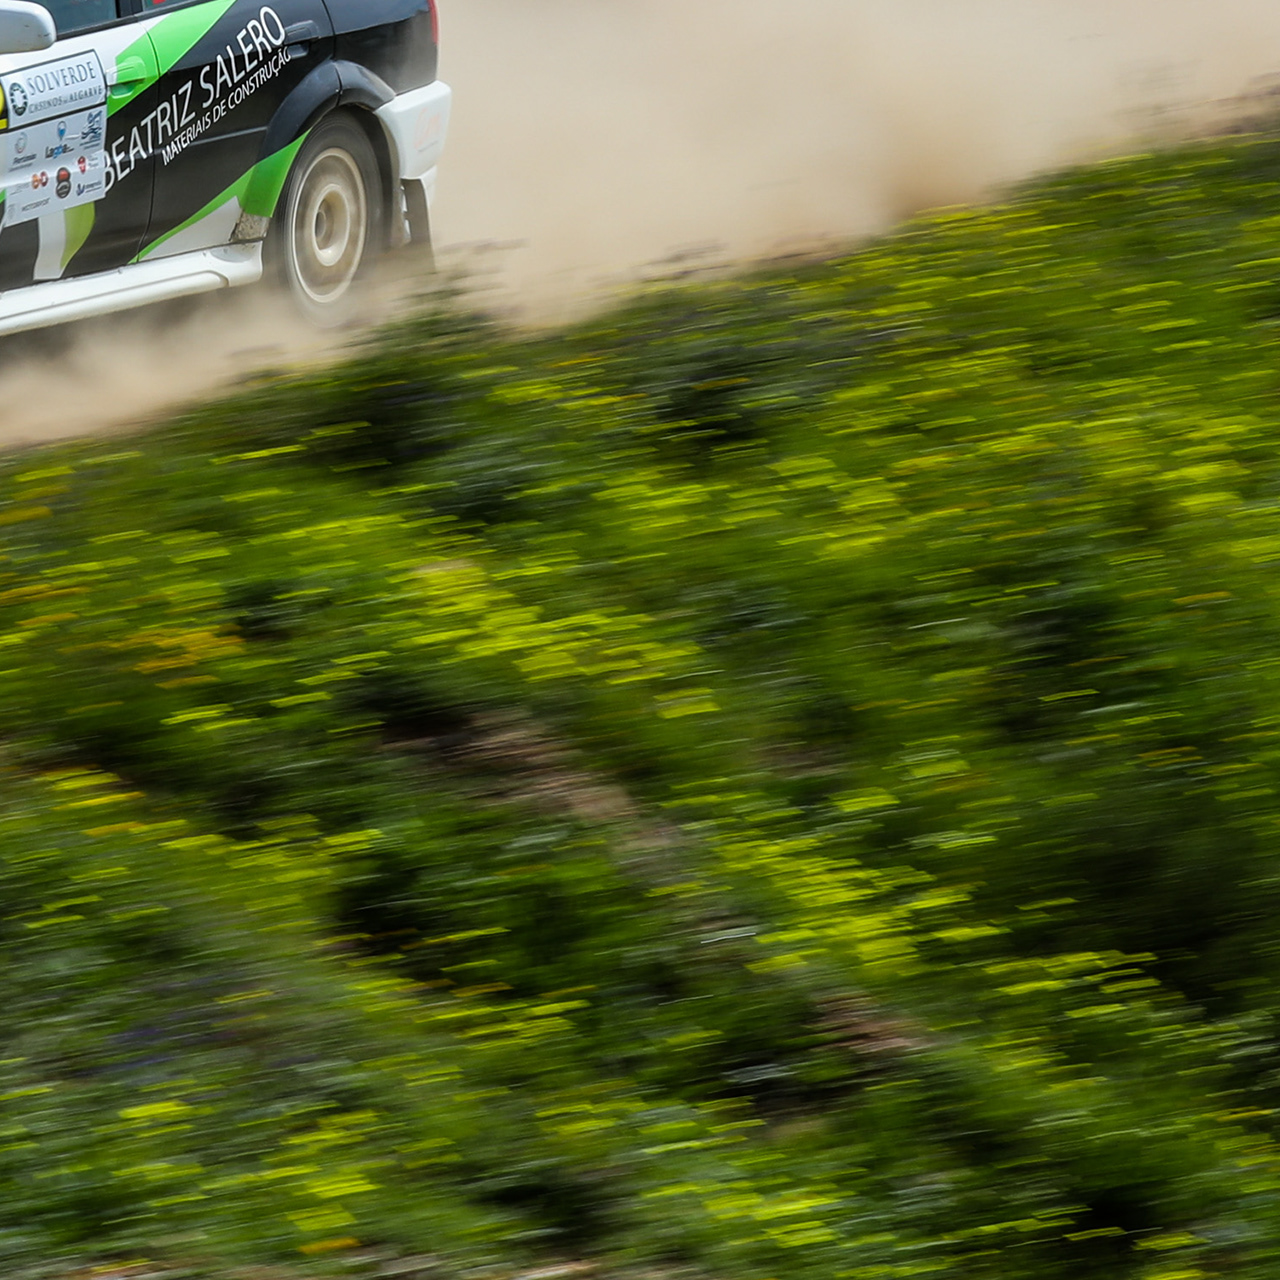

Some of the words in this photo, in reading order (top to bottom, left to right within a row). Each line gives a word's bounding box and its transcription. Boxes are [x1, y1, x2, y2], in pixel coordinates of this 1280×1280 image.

[26, 61, 97, 96] SOLVERDE
[198, 6, 286, 109] SALERO
[161, 111, 212, 166] MATERIAIS
[213, 99, 228, 124] DE
